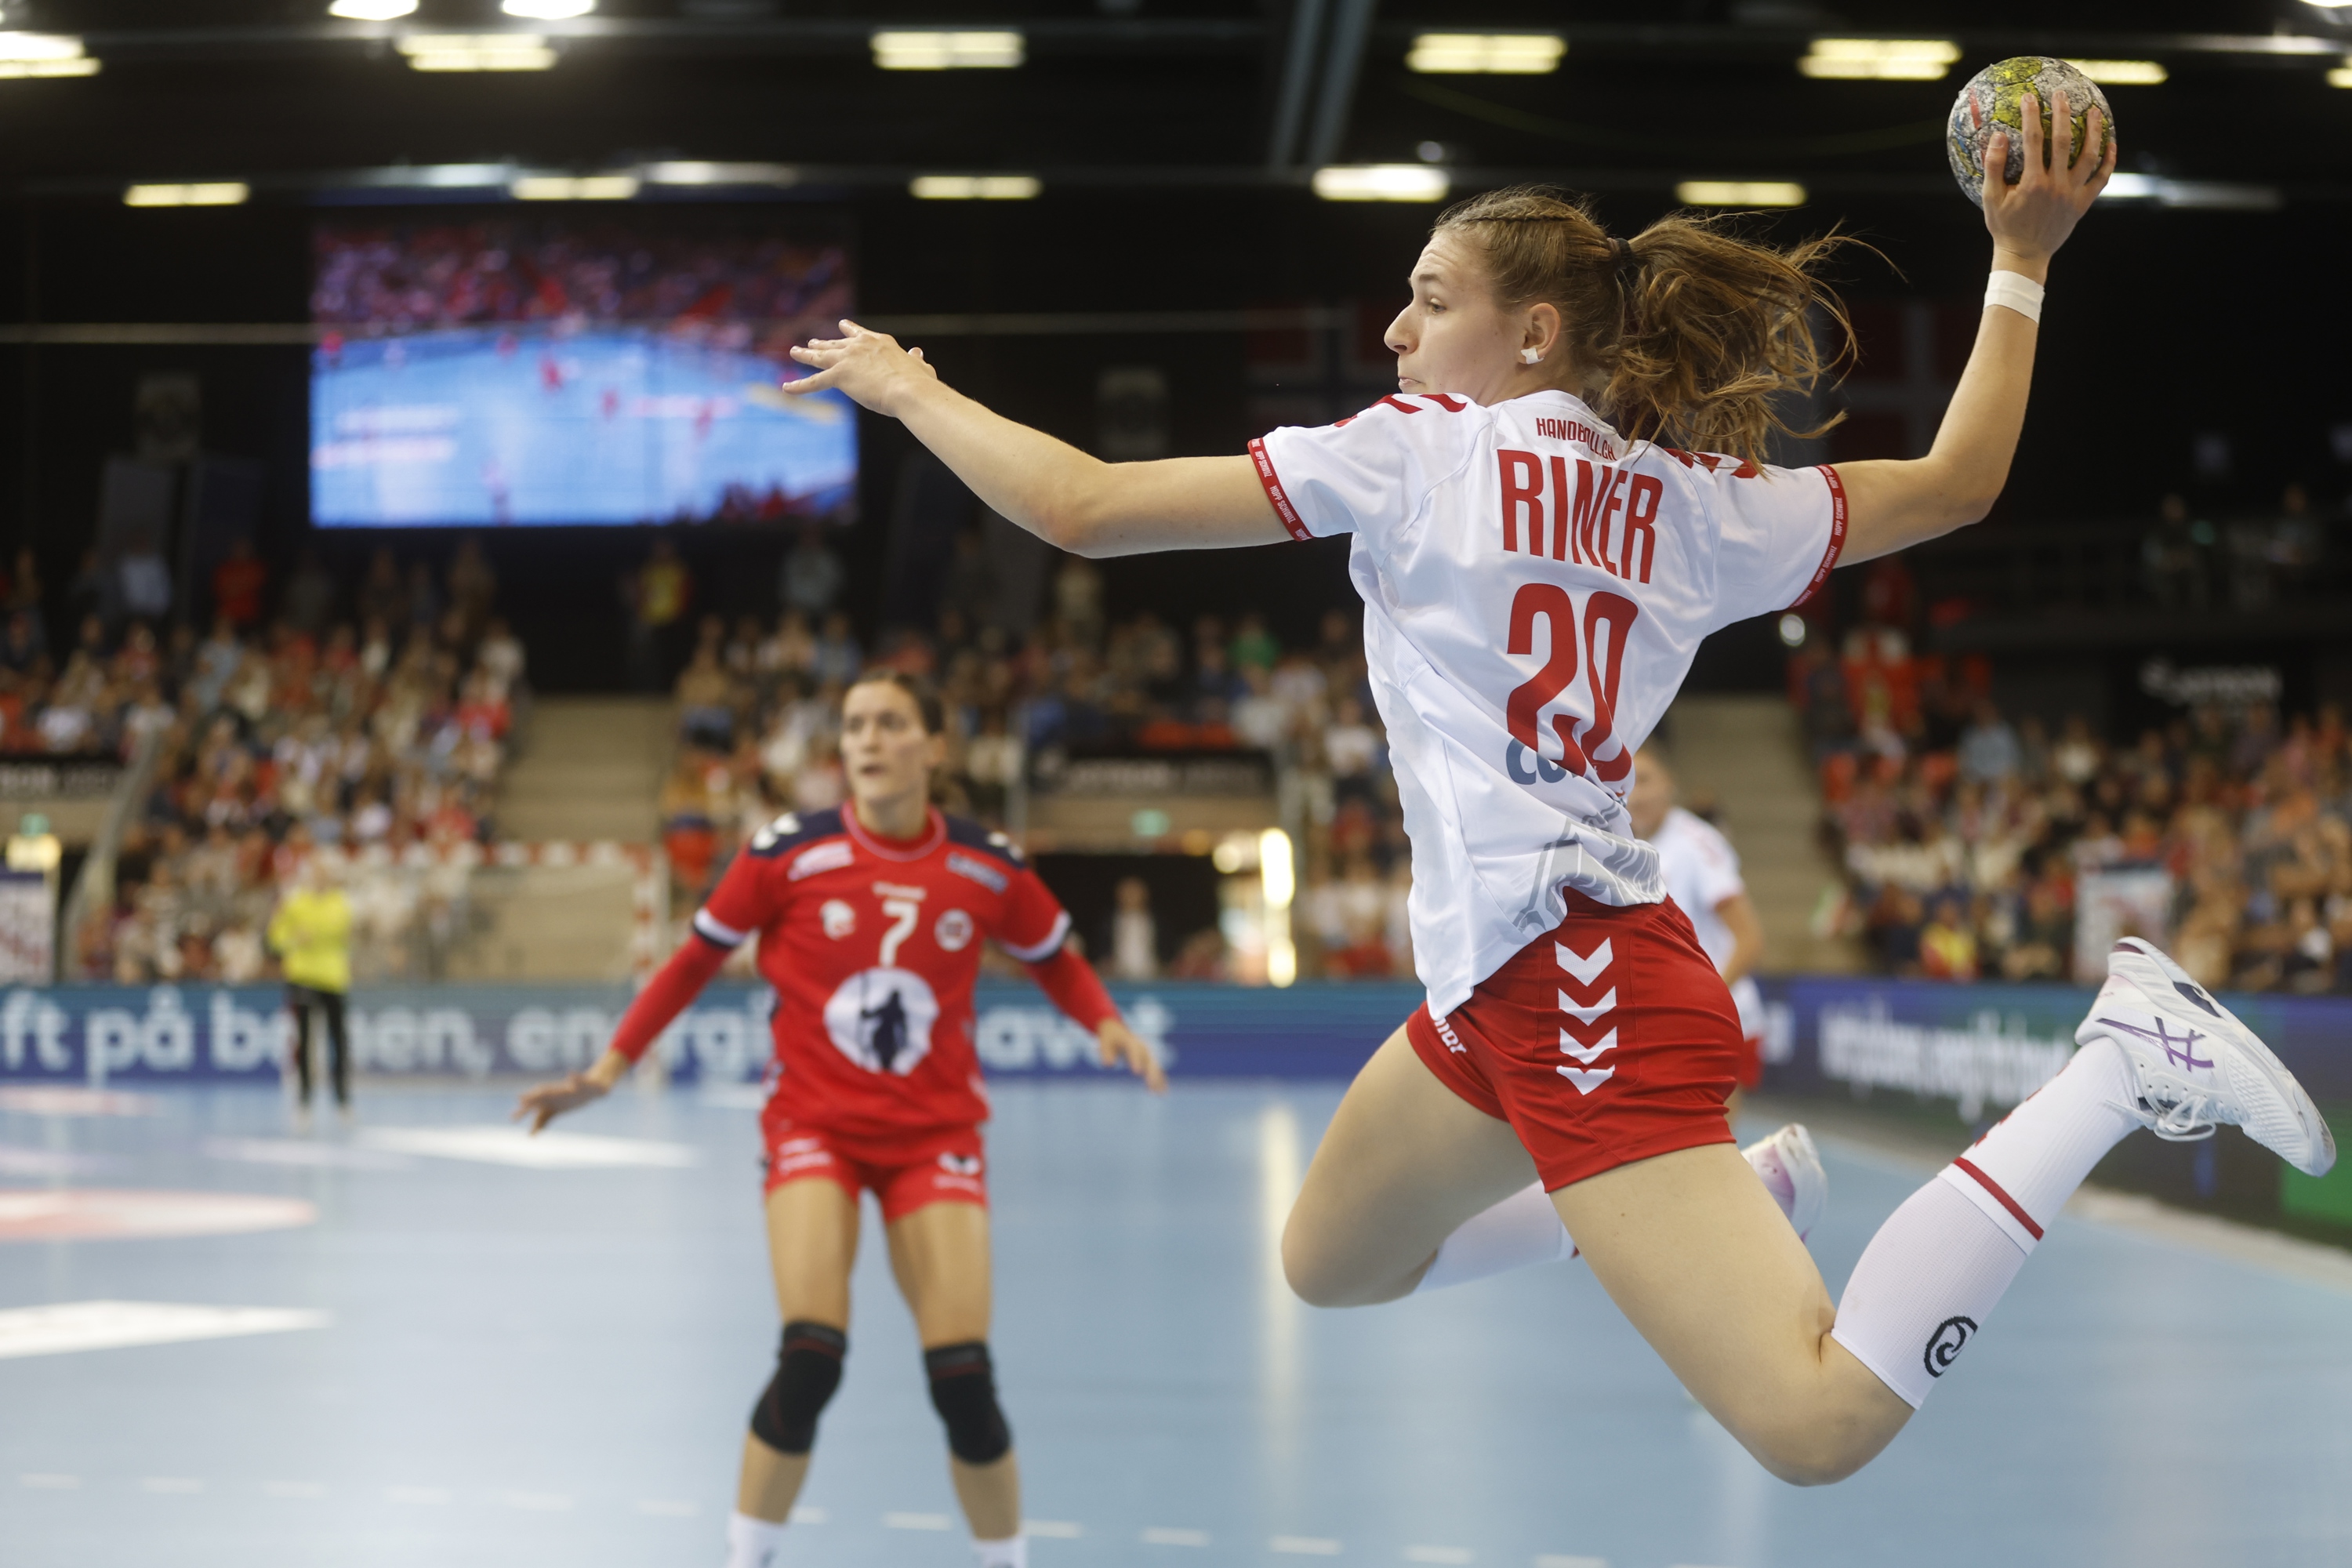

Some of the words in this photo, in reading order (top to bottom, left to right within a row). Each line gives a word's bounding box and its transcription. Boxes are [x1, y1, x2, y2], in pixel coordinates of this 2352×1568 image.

[1269, 485, 1283, 501] HOPP
[1497, 448, 1664, 584] RINER
[1834, 518, 1843, 536] HOPP
[1814, 567, 1827, 583] HOPP
[1506, 583, 1639, 782] 20
[878, 899, 920, 966] 7
[85, 982, 194, 1088] på
